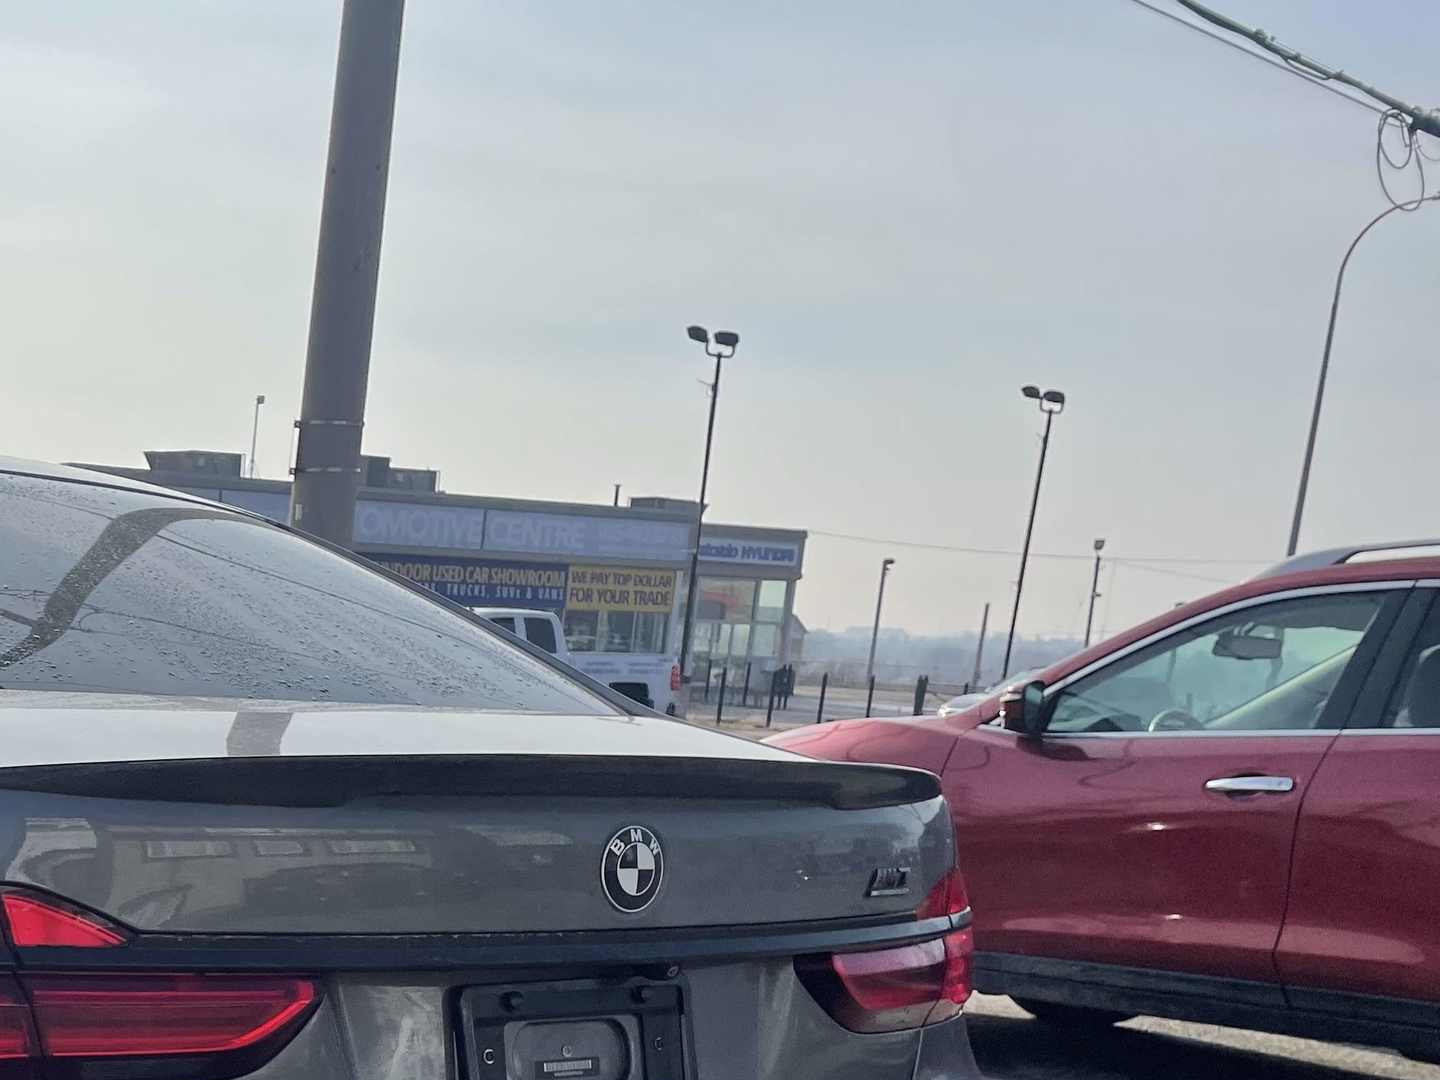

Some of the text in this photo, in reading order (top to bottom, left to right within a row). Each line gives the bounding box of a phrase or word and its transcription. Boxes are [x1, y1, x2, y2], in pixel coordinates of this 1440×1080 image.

[490, 516, 585, 550] CENTRE
[433, 565, 462, 582] USED
[465, 566, 489, 584] CAR
[491, 567, 564, 587] SHOWROOM
[571, 571, 672, 588] WE PAY TOP DOLLAR
[570, 587, 673, 607] FOR YOUR TRADE
[610, 829, 660, 856] BMW
